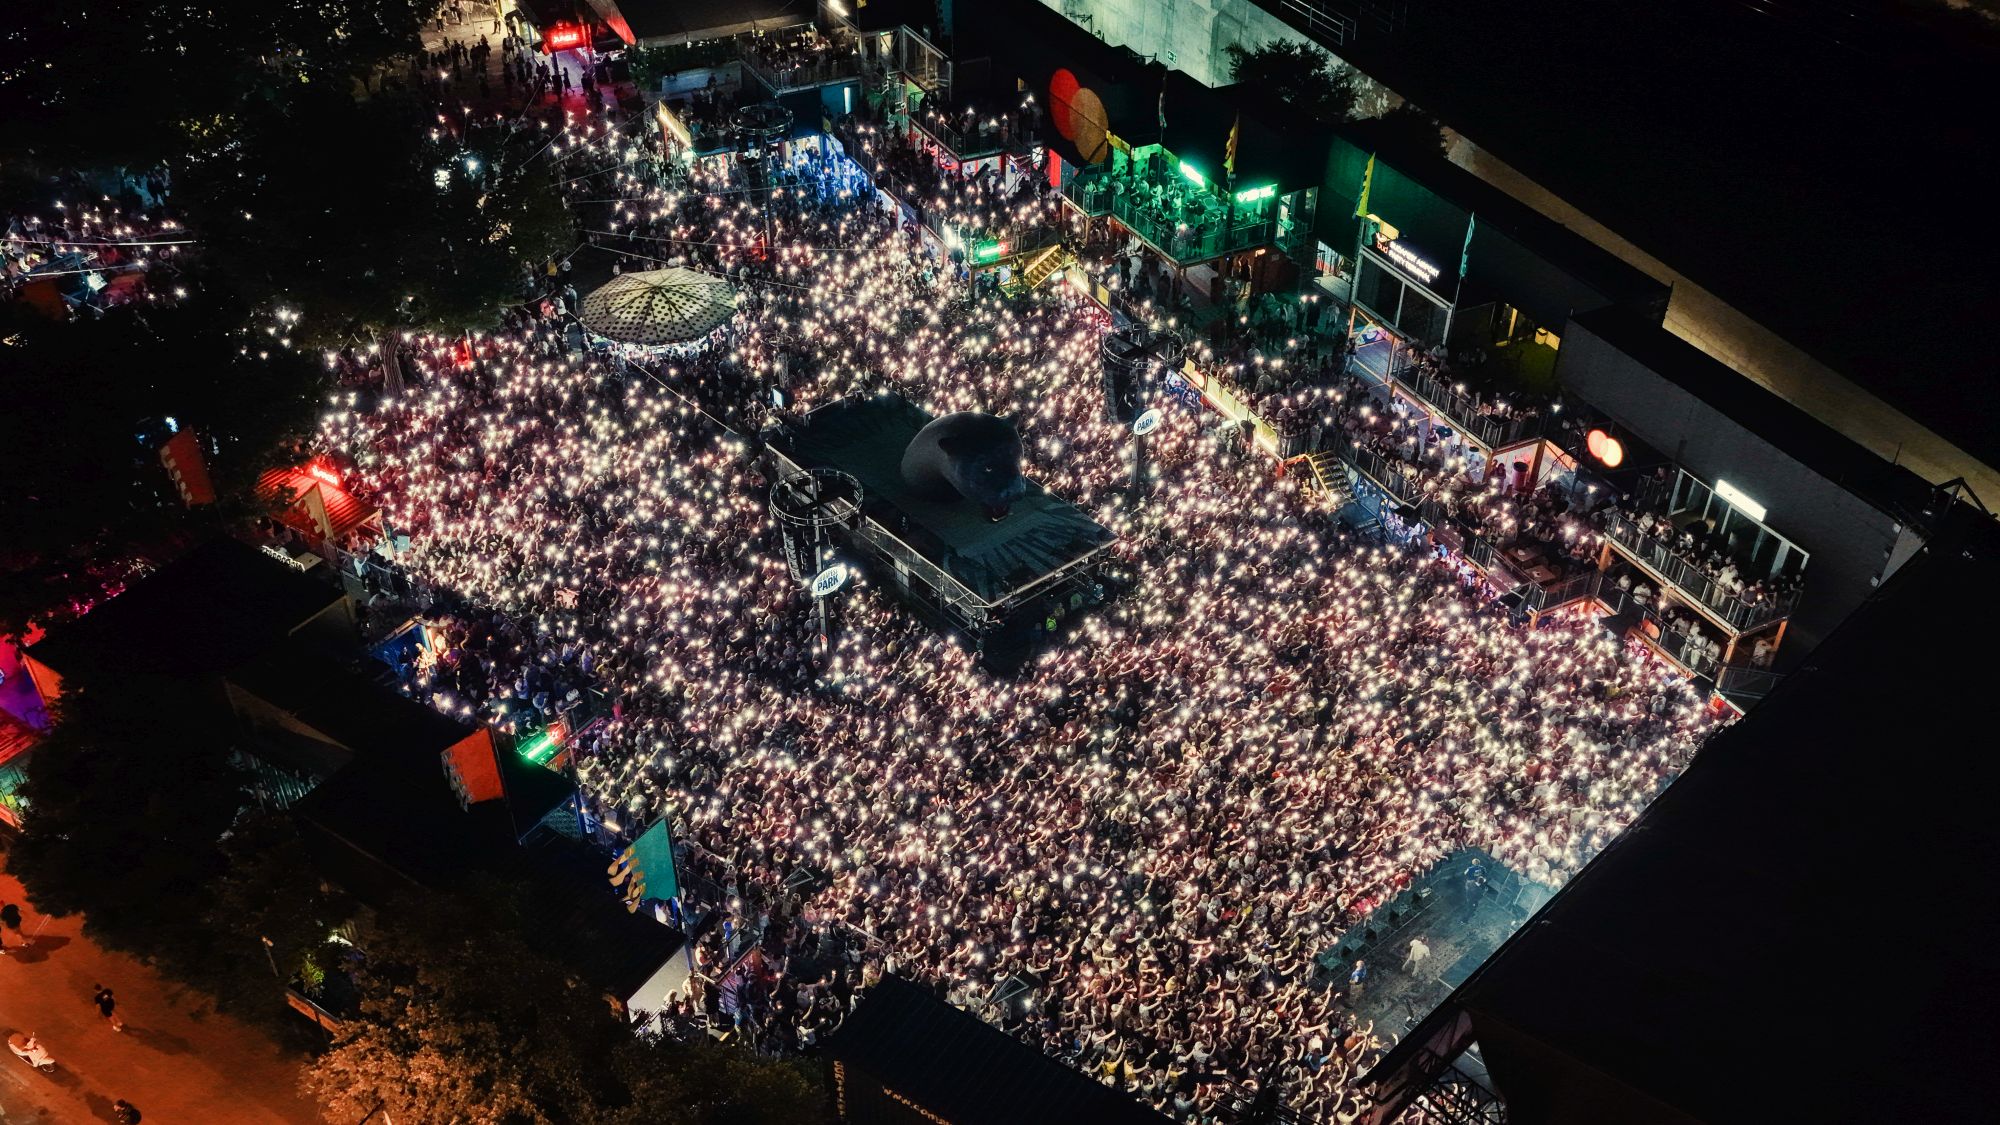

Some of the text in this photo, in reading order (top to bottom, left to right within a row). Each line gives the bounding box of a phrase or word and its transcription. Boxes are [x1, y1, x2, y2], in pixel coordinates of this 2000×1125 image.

[1376, 241, 1388, 254] bud
[1137, 416, 1153, 431] PARK
[817, 574, 839, 591] PARK
